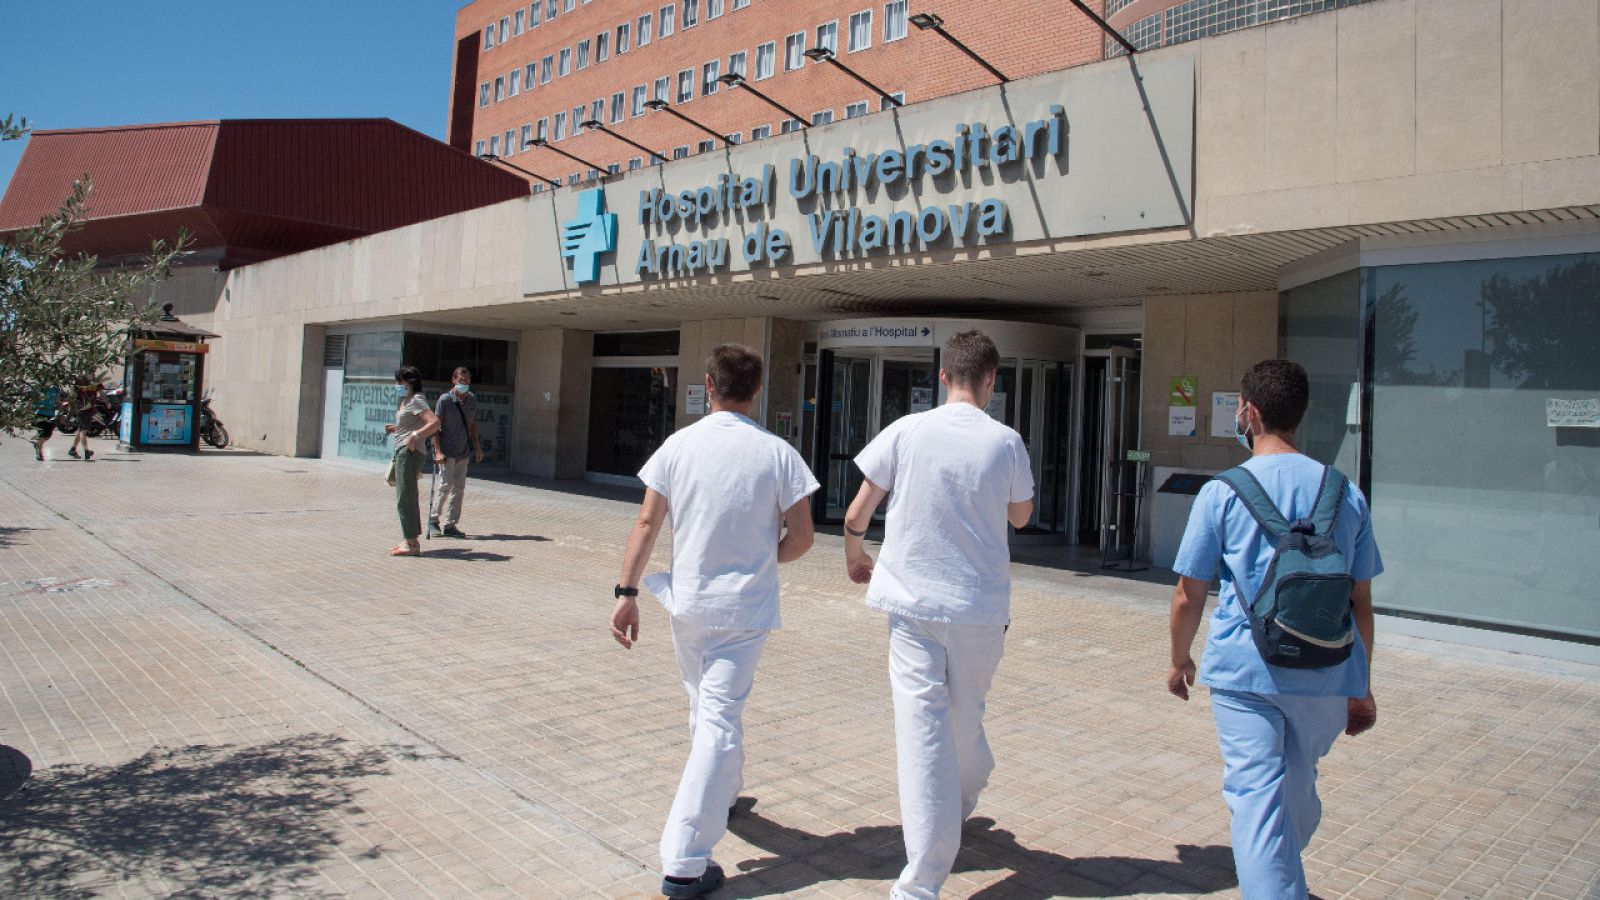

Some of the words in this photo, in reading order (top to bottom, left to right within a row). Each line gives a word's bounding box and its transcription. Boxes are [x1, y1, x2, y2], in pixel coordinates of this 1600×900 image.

[638, 164, 775, 226] Hospital
[789, 104, 1064, 199] Universitari
[635, 238, 729, 275] Arnau
[742, 222, 790, 263] de
[808, 198, 1008, 259] Vilanova
[348, 385, 396, 410] premsa
